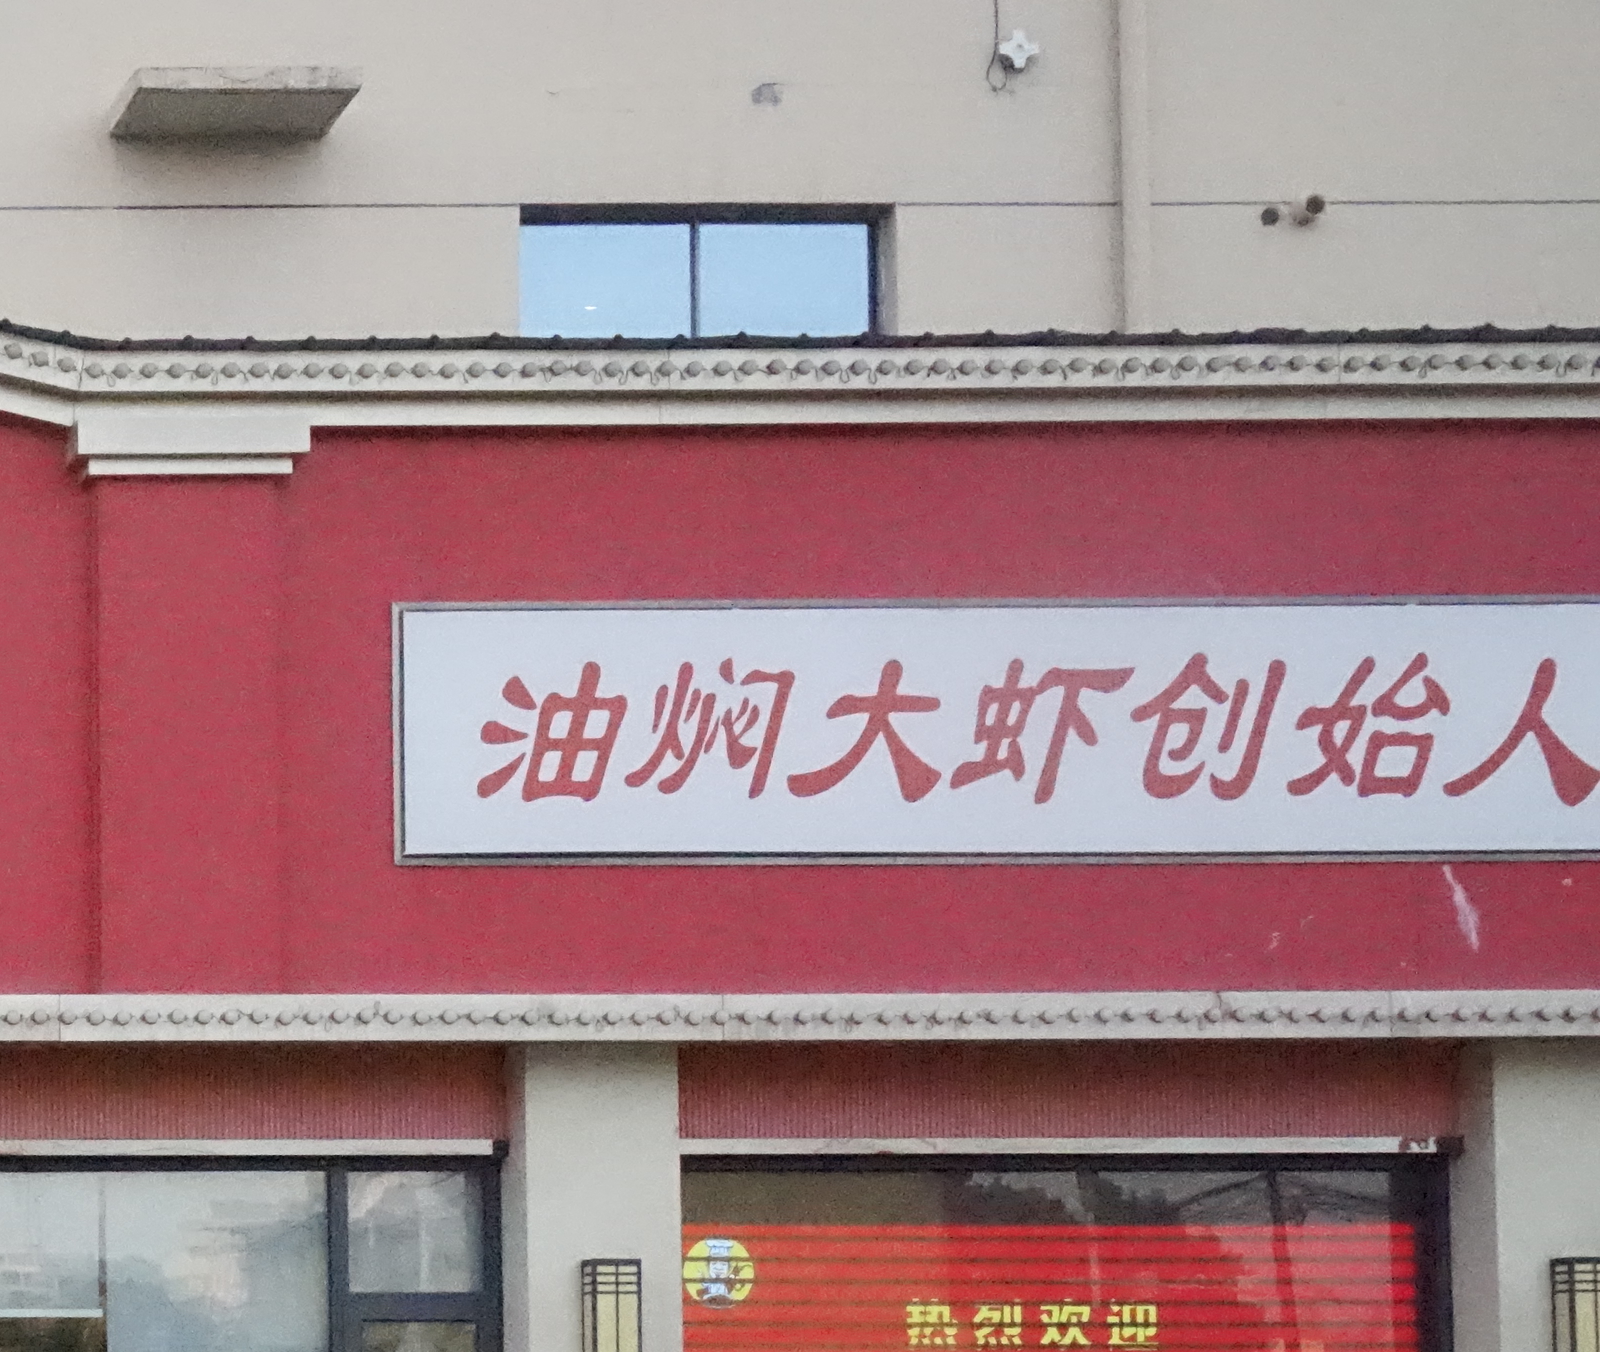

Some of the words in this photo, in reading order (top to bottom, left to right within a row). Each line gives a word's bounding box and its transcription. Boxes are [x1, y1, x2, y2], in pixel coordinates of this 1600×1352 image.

[476, 652, 1600, 807] 油焖大虾创始人
[906, 1299, 1160, 1350] 热烈欢迎
